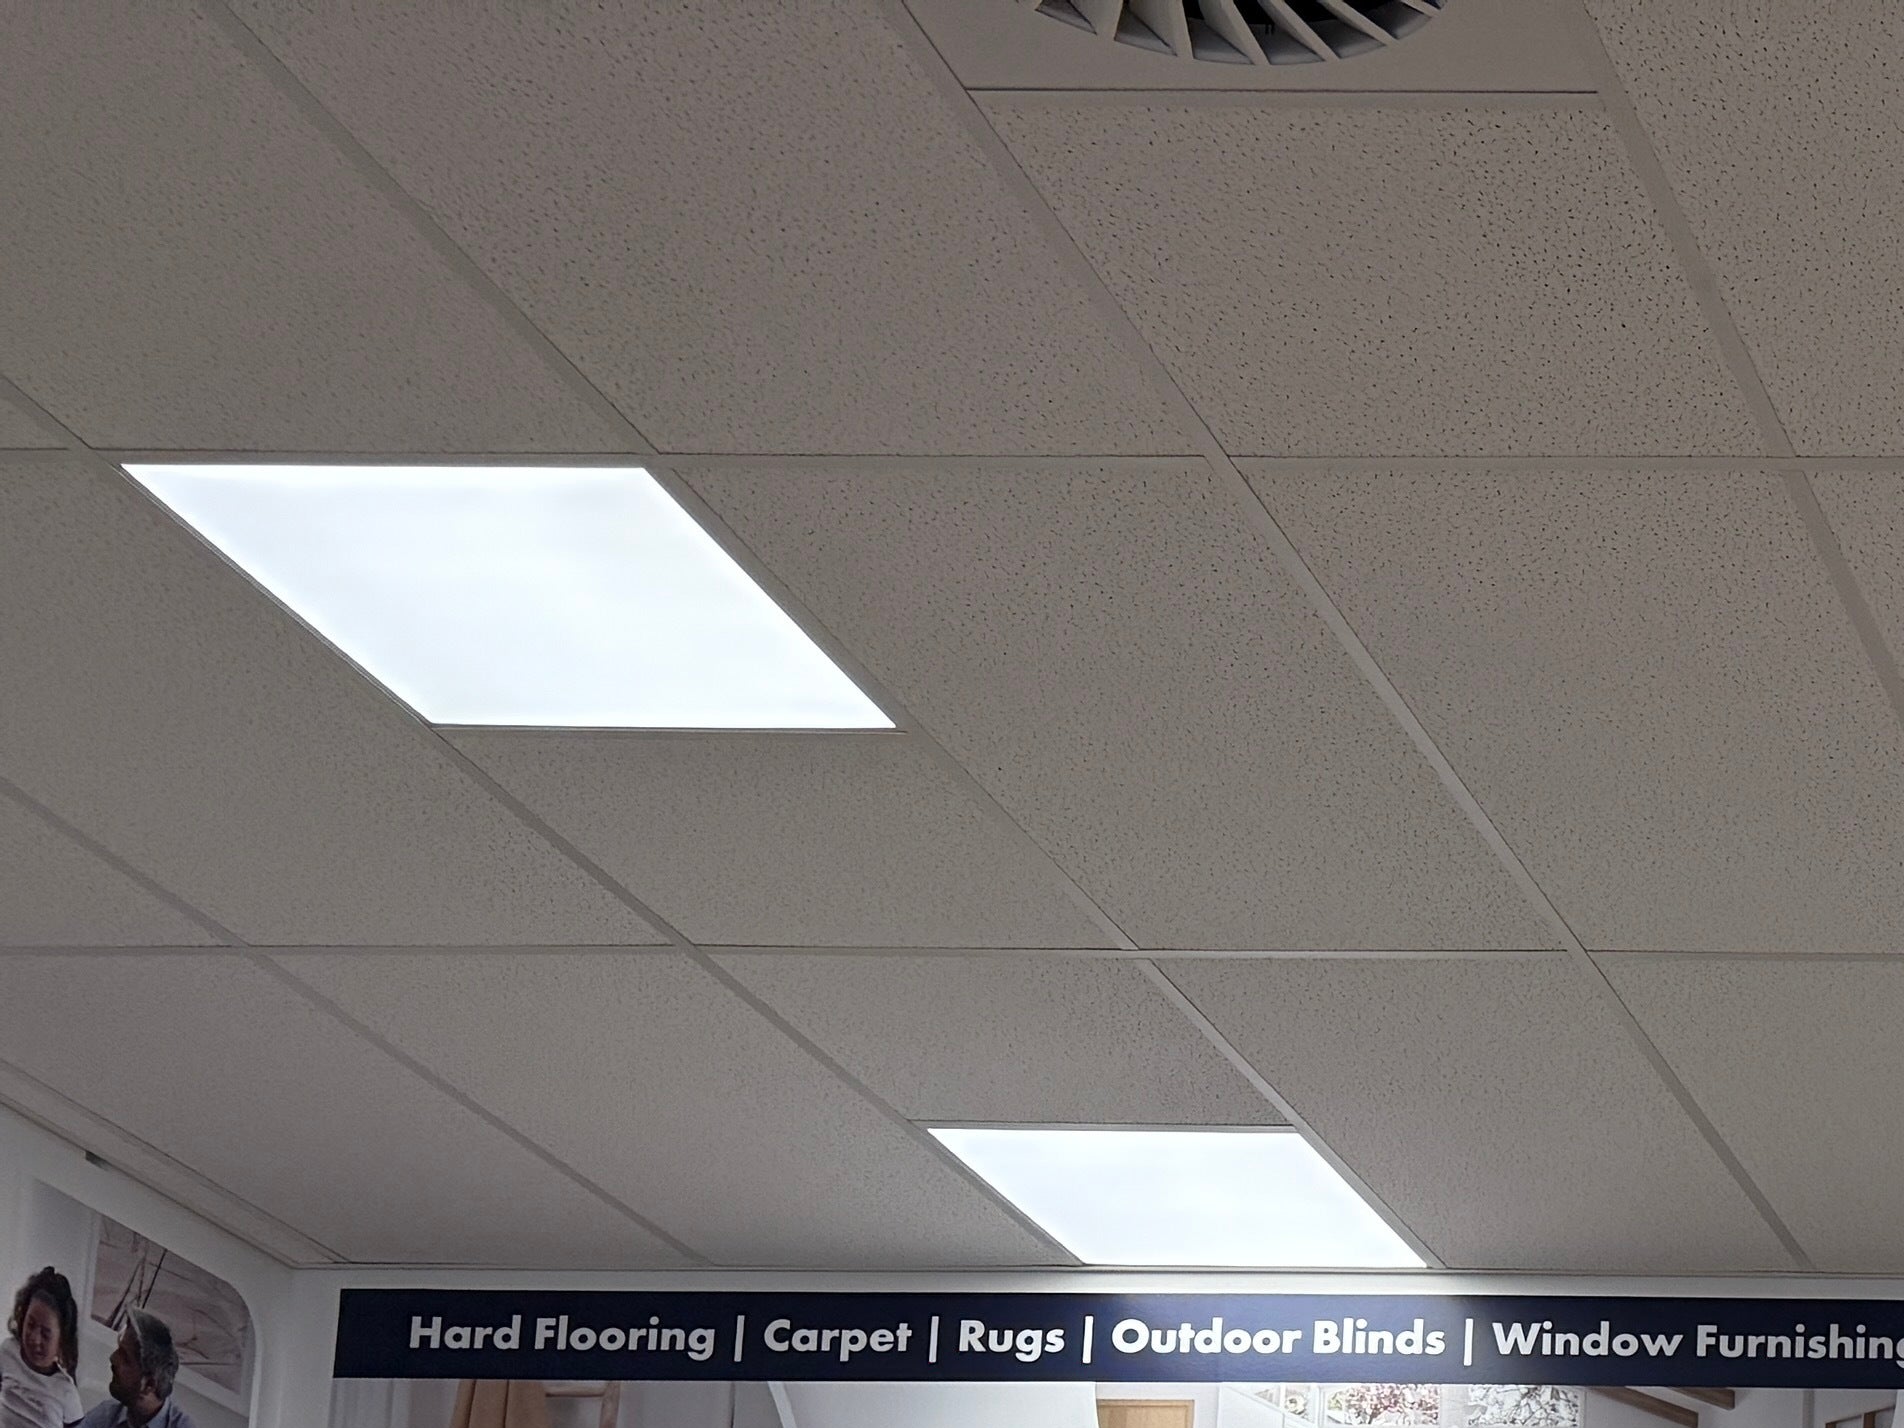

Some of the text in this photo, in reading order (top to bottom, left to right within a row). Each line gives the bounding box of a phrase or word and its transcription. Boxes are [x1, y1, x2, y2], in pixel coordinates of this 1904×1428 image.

[409, 1315, 521, 1349] Hard
[534, 1315, 716, 1361] Flooring
[764, 1318, 912, 1362] Carpet
[958, 1319, 1066, 1362] Rugs
[1111, 1317, 1303, 1354] Outdoor
[1313, 1317, 1447, 1355] Blinds
[1492, 1321, 1684, 1357] Window
